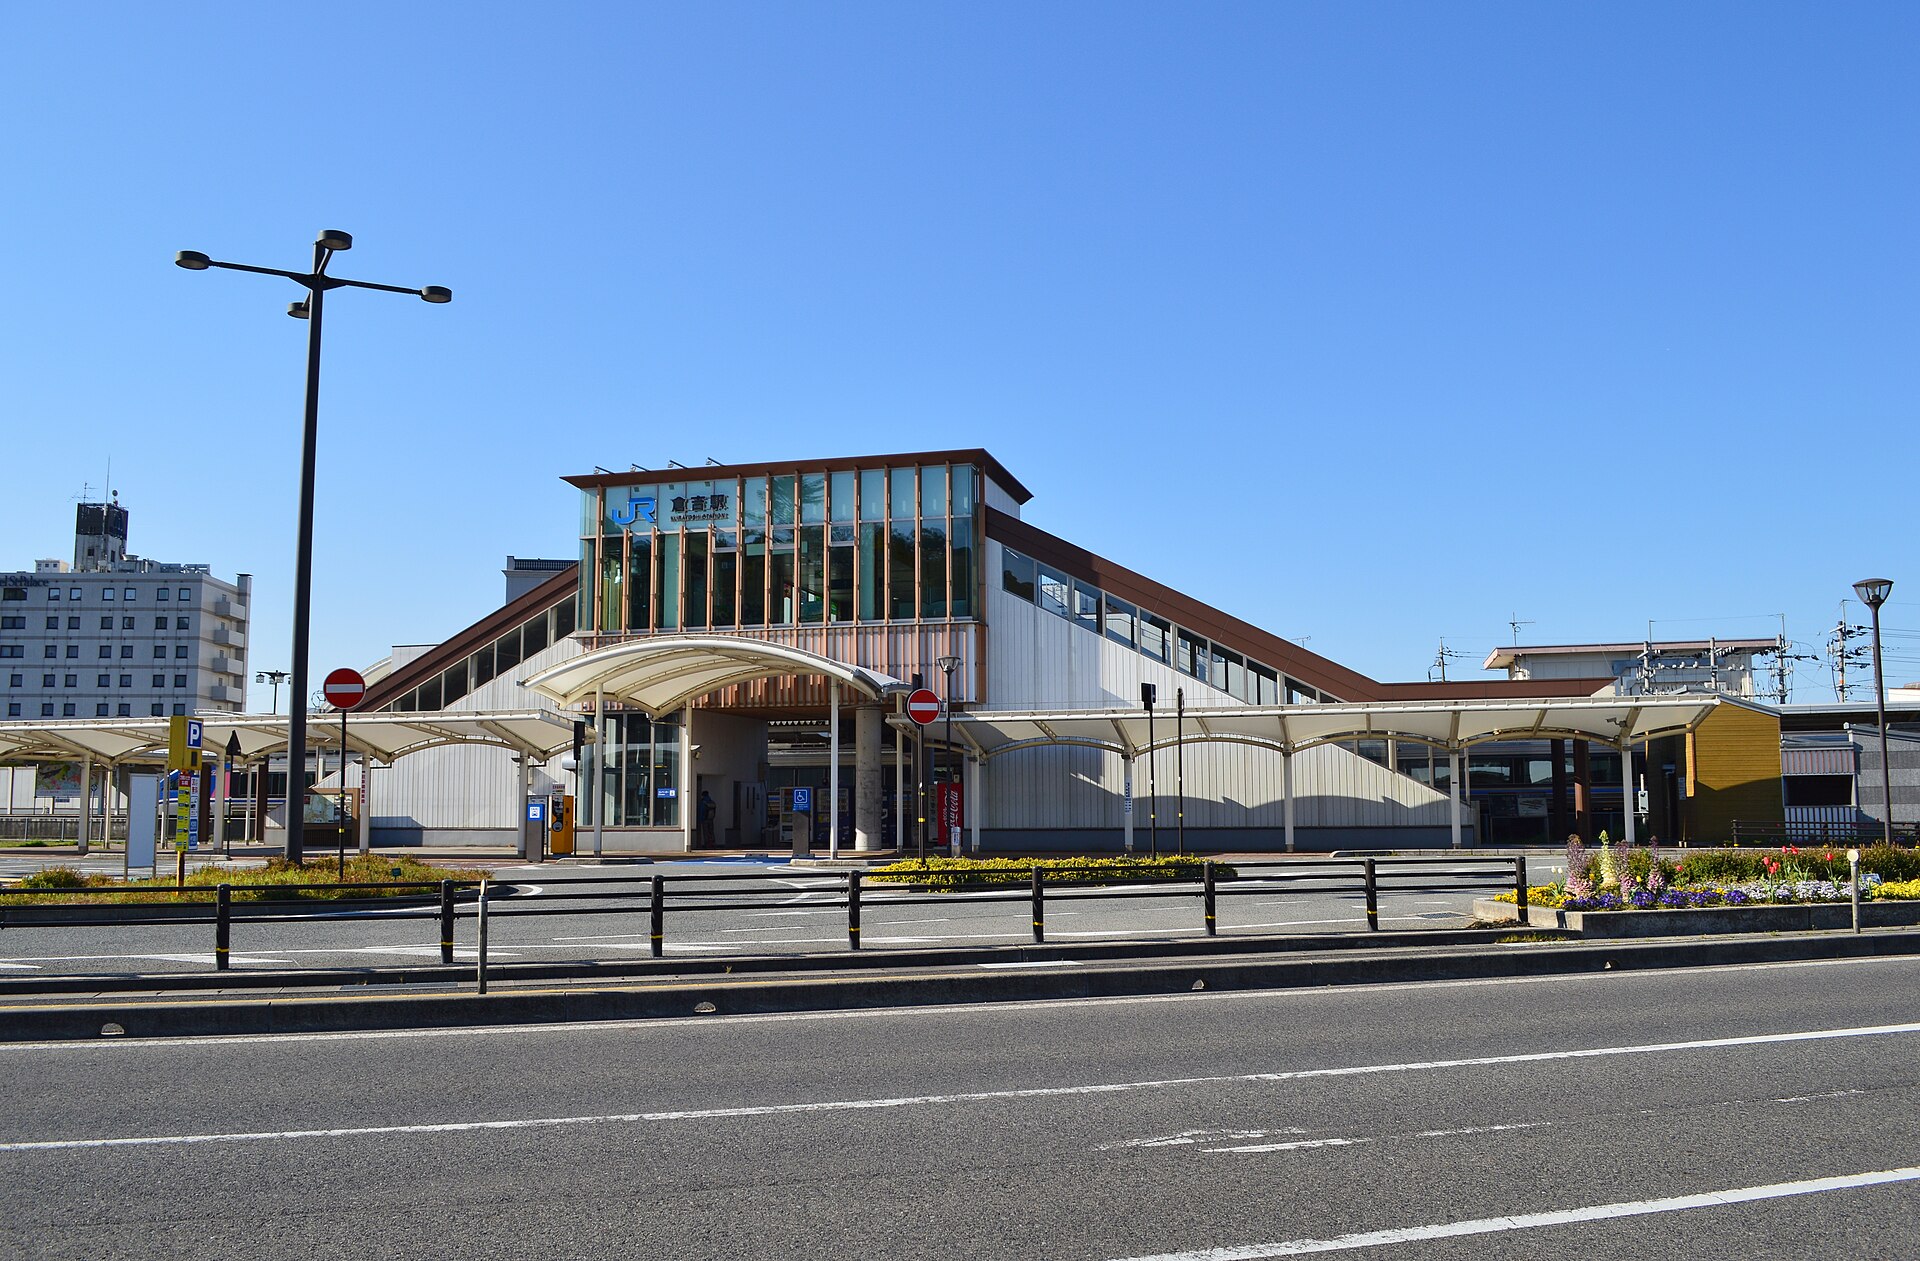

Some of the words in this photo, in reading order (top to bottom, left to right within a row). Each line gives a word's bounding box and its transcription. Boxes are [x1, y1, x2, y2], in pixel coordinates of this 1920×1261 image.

[612, 497, 656, 525] JR
[671, 494, 729, 512] 倉吉駅
[190, 723, 200, 745] P
